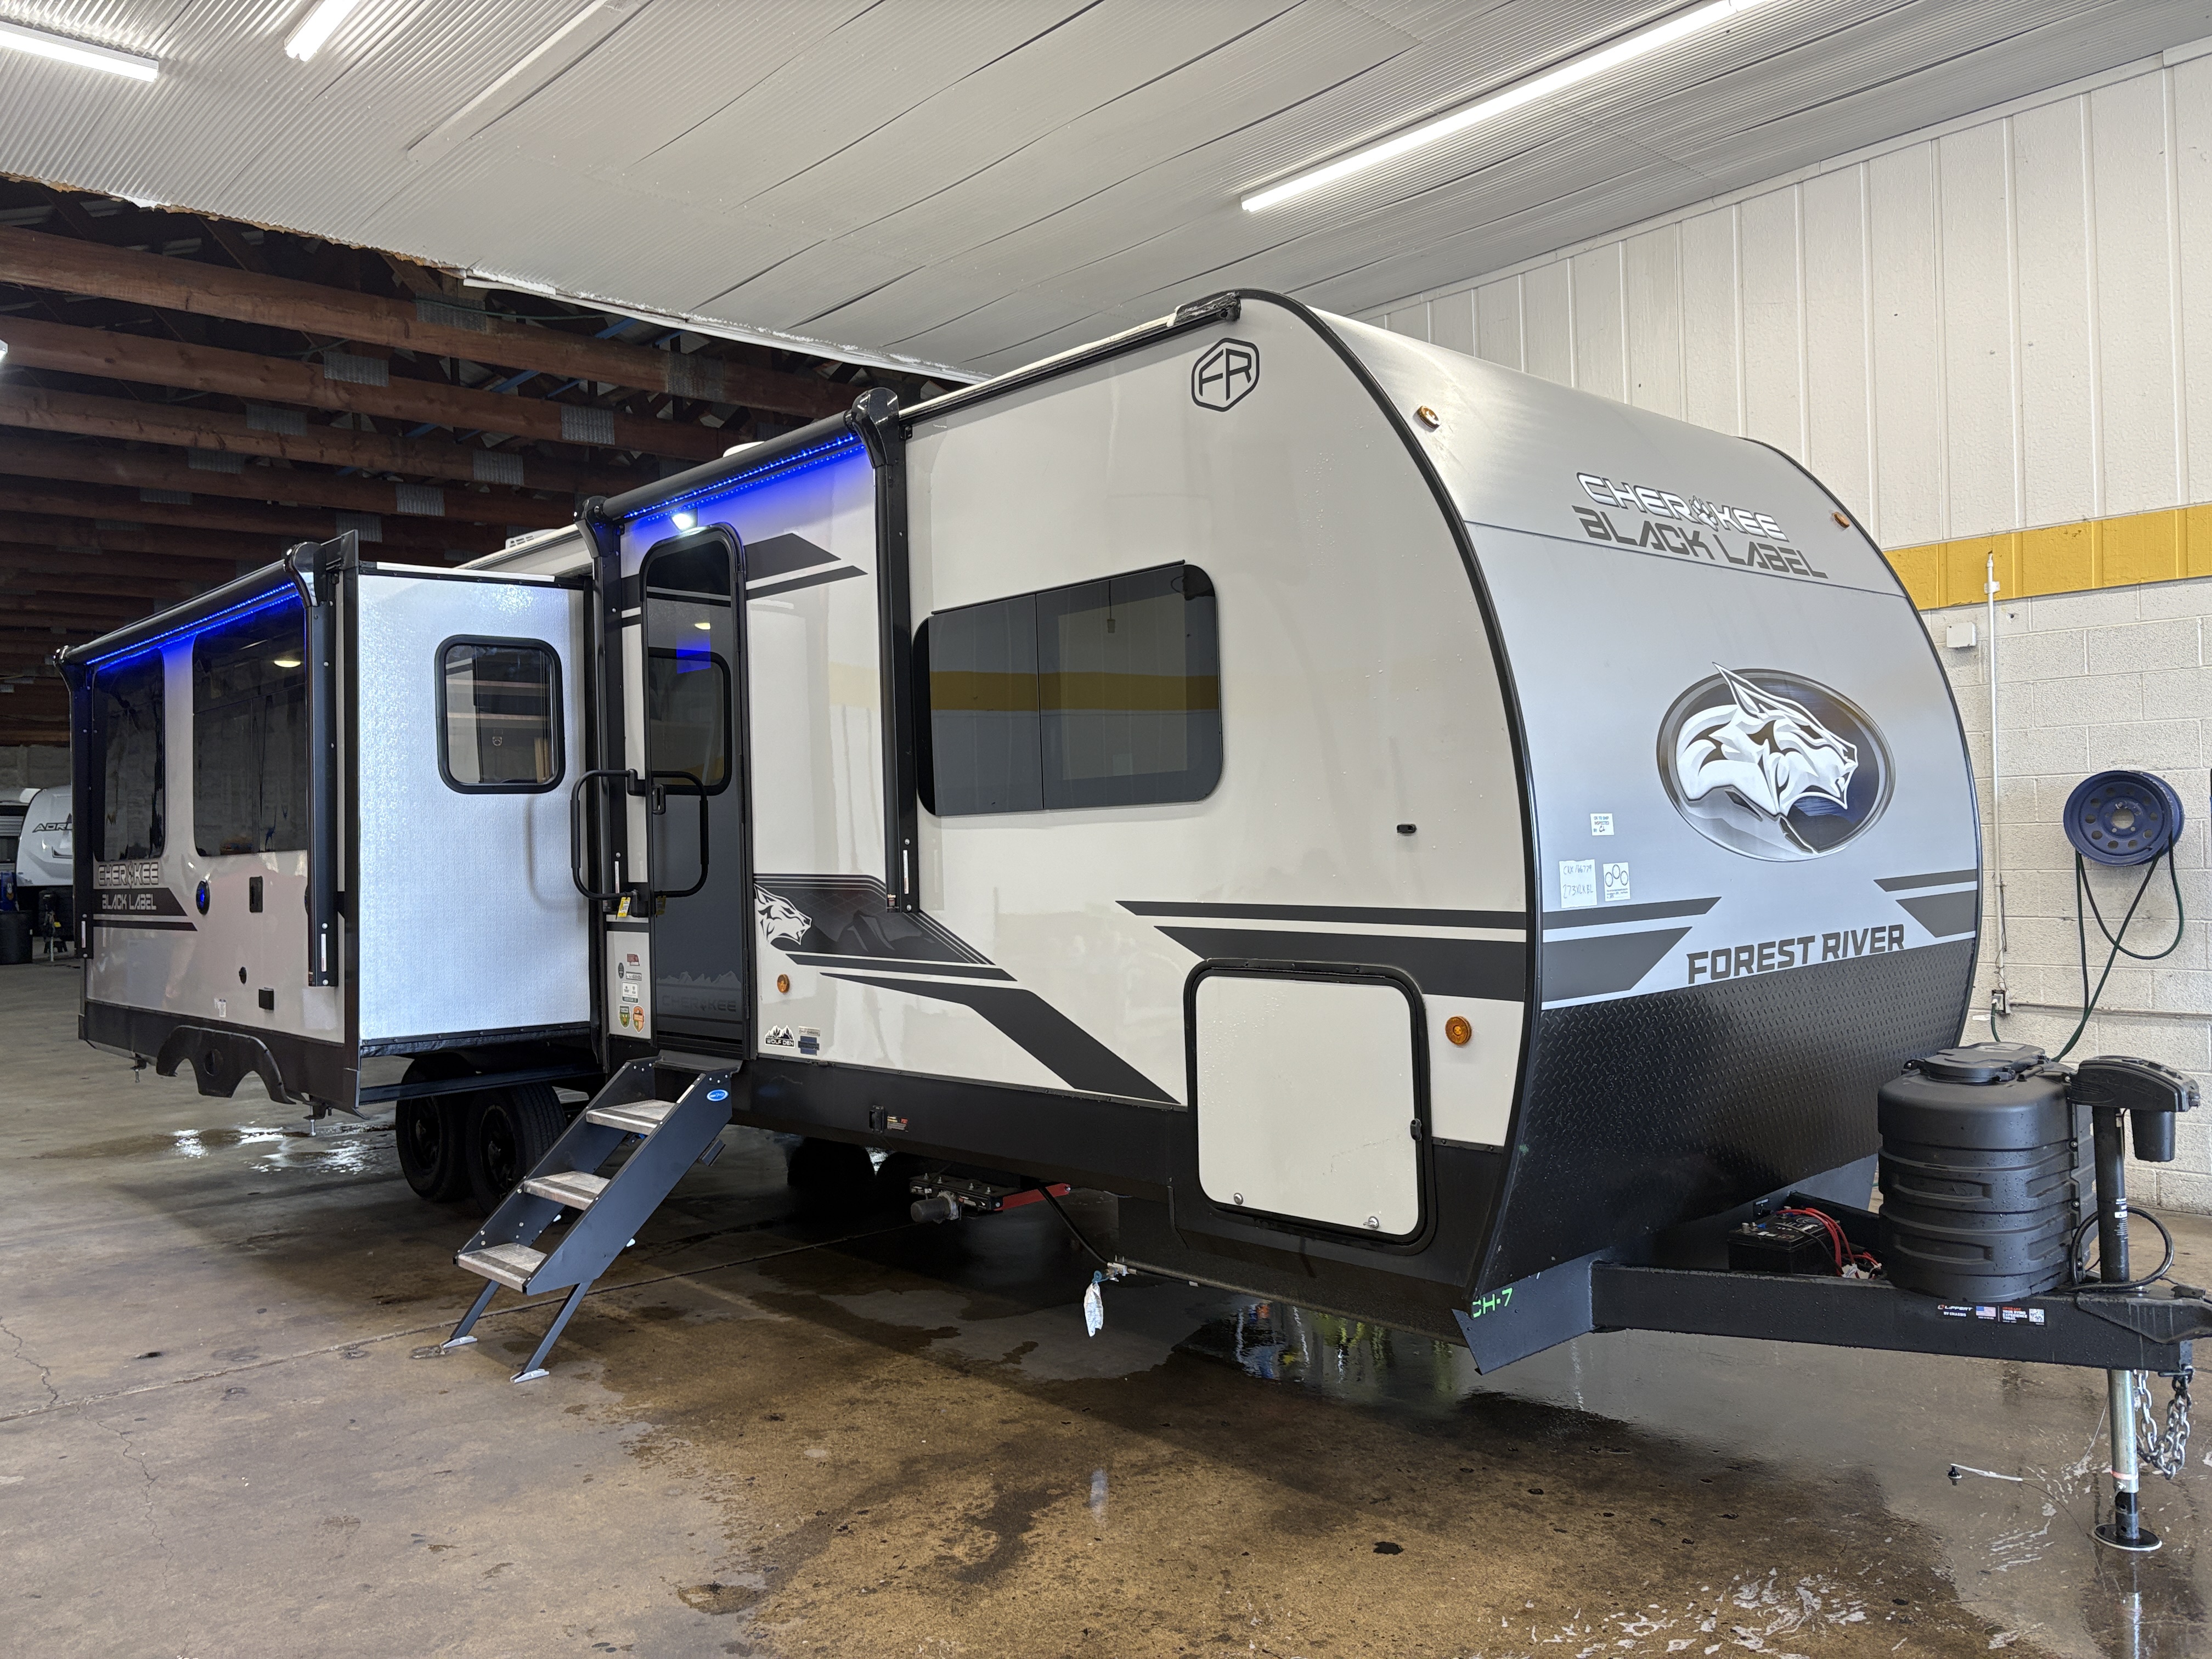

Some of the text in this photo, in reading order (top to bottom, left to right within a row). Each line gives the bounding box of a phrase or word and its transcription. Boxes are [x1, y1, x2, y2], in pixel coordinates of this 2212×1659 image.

[1572, 505, 1828, 579] BLACK LABEL
[102, 894, 157, 910] BLACK LABEL
[1687, 924, 1905, 984] FOREST RIVER
